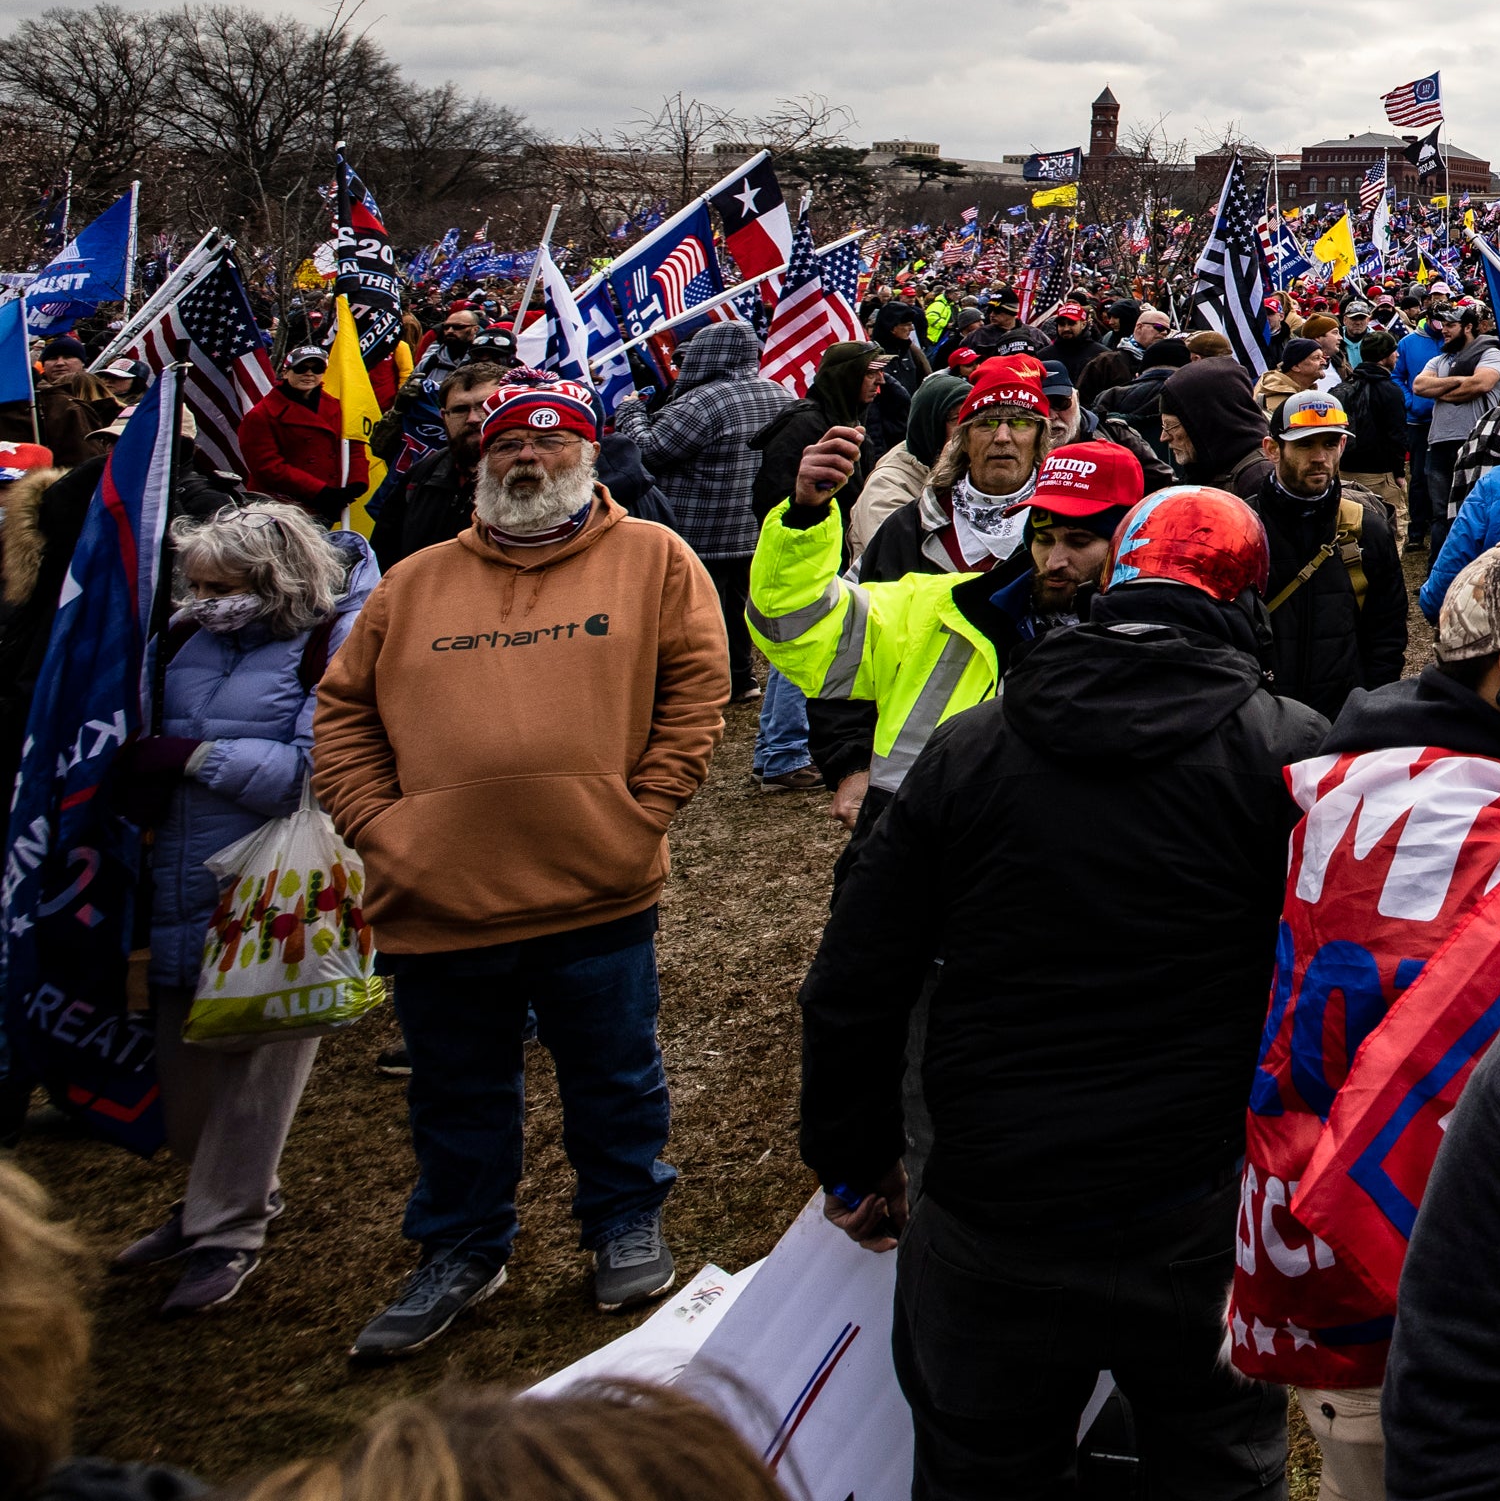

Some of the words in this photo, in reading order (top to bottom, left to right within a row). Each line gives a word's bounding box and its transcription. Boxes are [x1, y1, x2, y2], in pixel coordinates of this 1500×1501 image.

[972, 389, 1039, 411] TRUMP
[1043, 456, 1097, 477] Trump
[1050, 471, 1074, 480] 2020
[1073, 482, 1090, 490] AGAIN
[431, 622, 580, 651] carhartt
